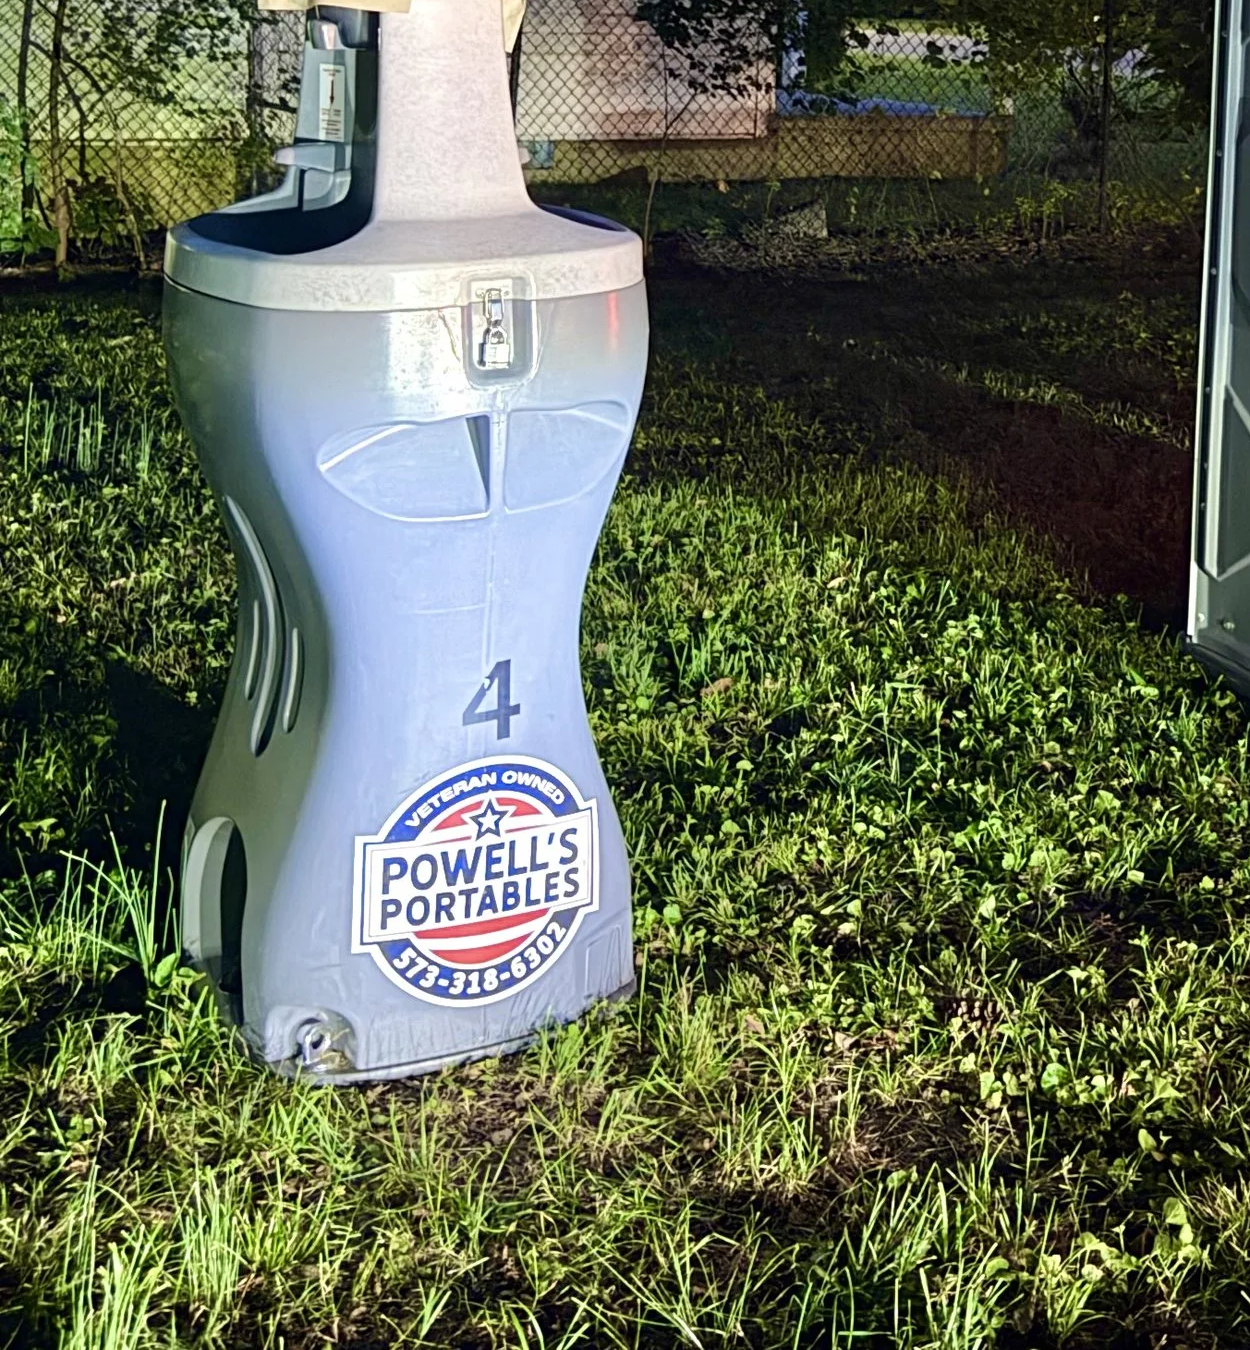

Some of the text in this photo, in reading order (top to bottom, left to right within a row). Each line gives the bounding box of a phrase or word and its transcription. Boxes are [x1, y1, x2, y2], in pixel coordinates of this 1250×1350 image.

[462, 658, 520, 740] 4
[404, 769, 566, 828] VETERAN OWNED
[381, 827, 578, 895] POWELL'S
[380, 867, 580, 931] PORTABLES
[391, 921, 566, 995] 573-318-6302
